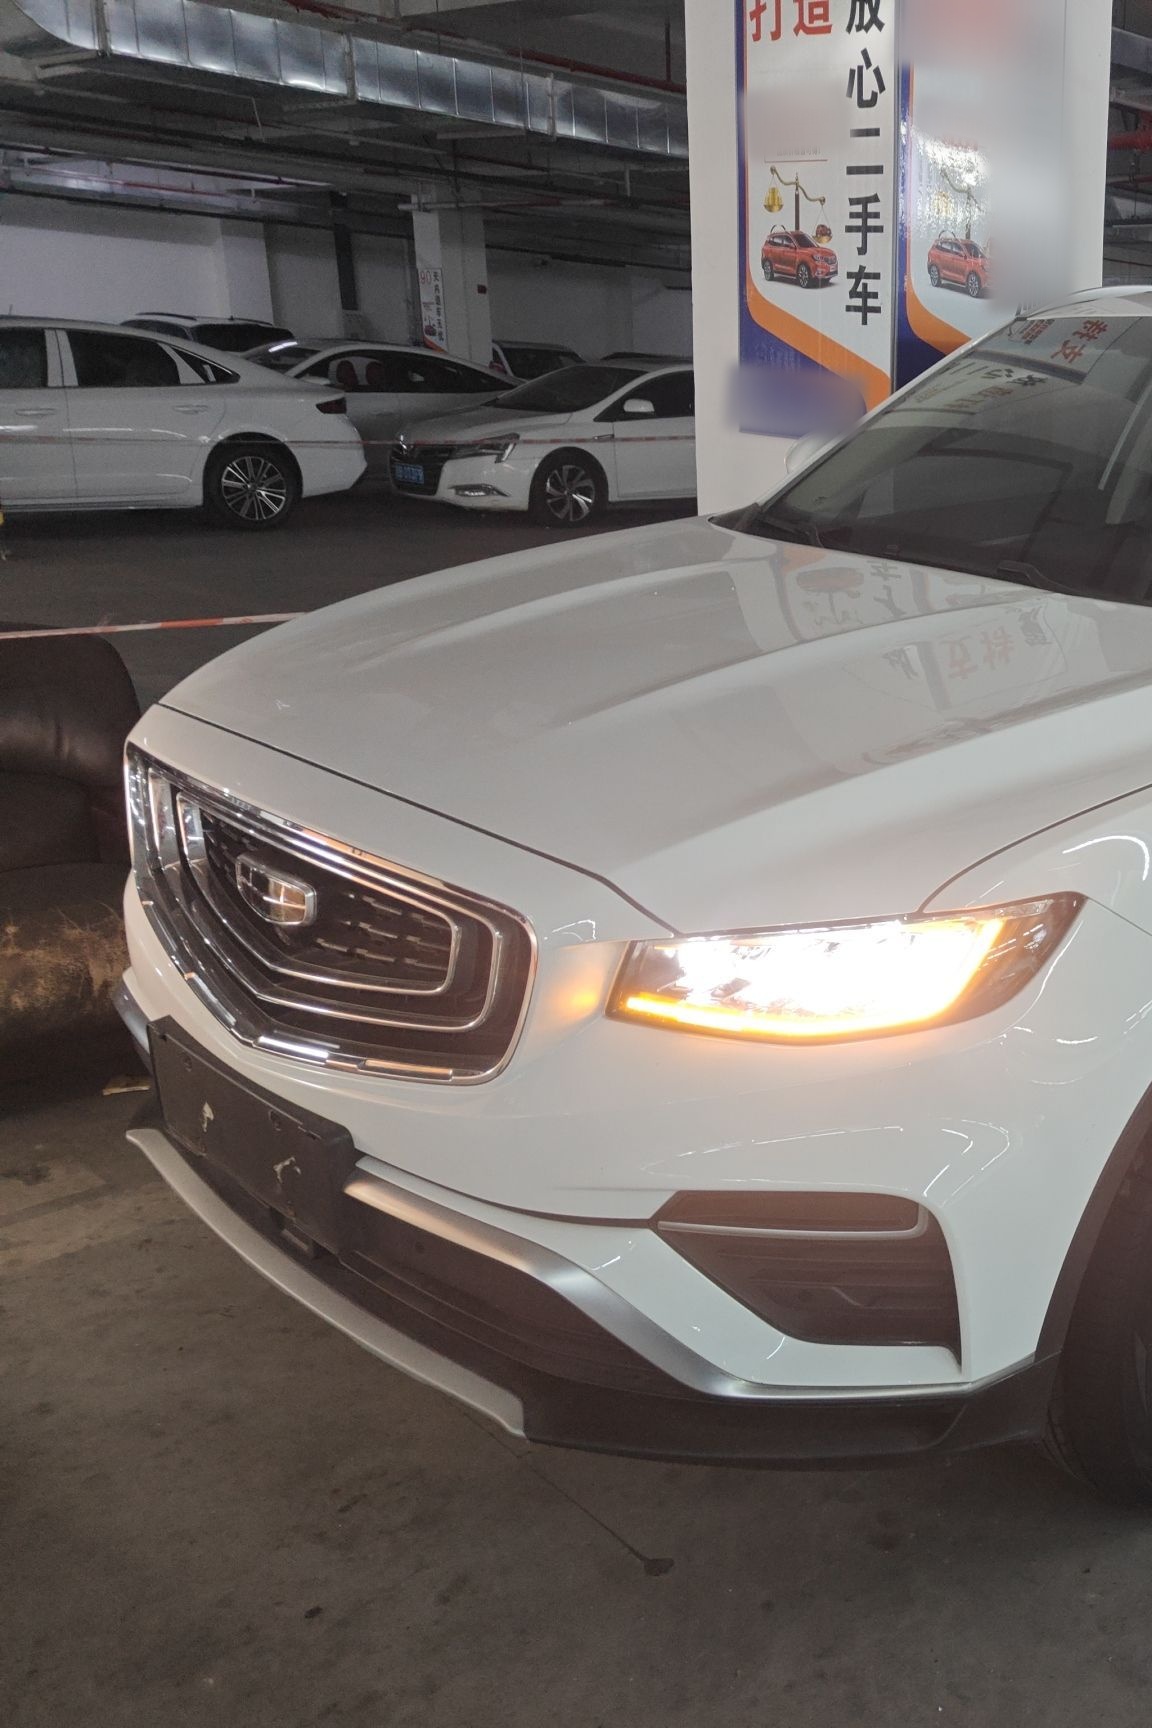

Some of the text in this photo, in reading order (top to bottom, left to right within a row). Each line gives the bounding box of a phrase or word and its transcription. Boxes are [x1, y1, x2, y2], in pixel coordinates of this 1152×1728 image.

[748, 0, 833, 42] 打造
[845, 0, 886, 326] 放心二手车
